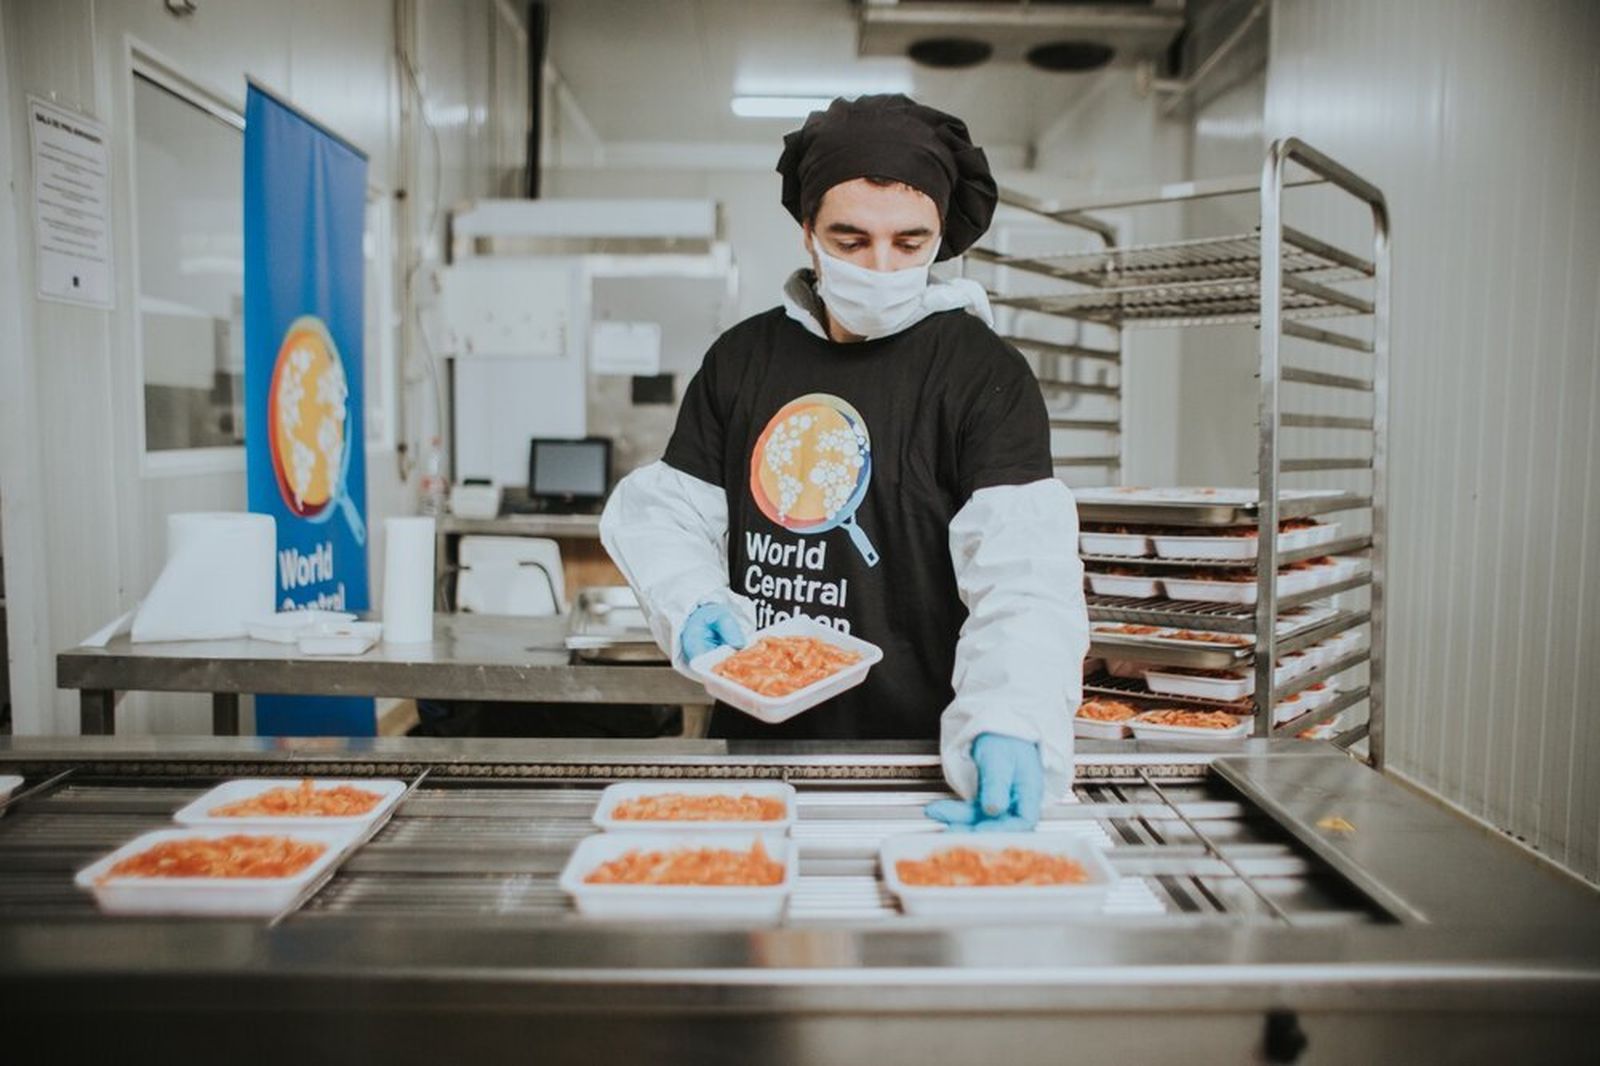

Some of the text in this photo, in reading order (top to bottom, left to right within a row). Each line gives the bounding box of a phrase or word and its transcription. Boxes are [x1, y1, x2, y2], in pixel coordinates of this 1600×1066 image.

[279, 541, 333, 590] World
[745, 531, 827, 570] World
[745, 564, 848, 608] Central
